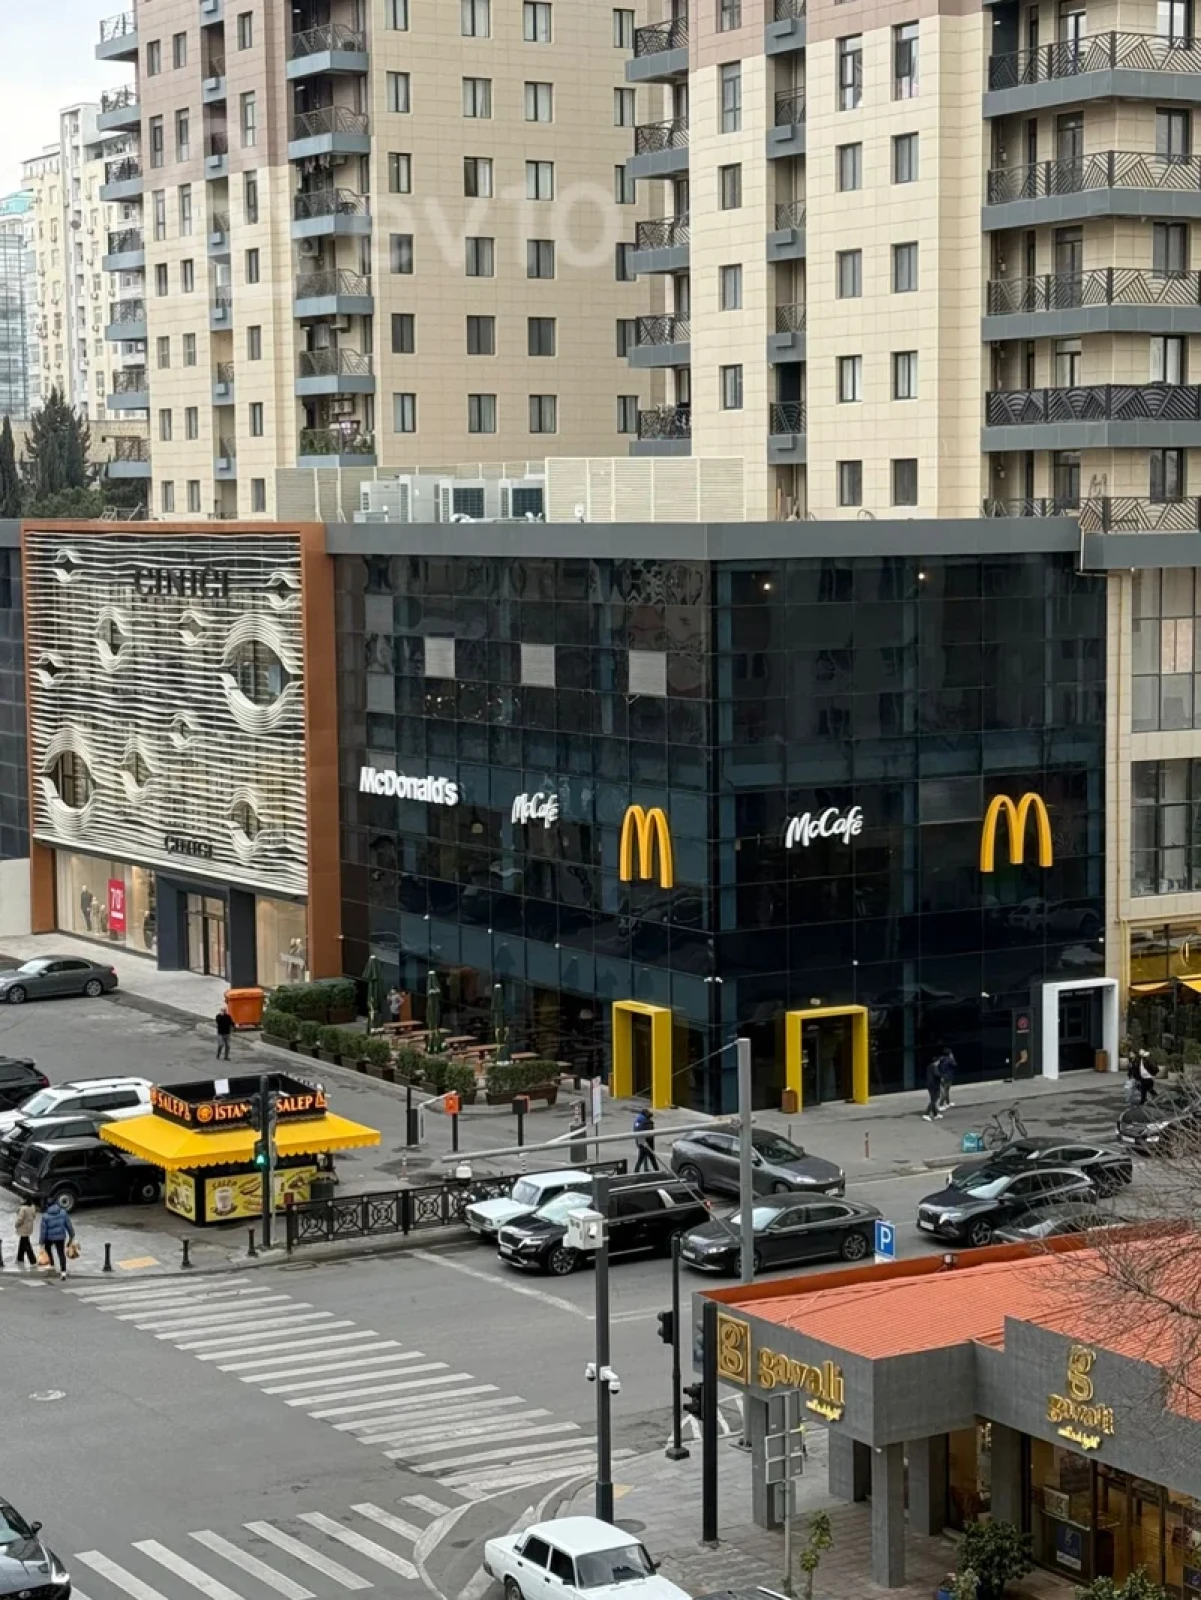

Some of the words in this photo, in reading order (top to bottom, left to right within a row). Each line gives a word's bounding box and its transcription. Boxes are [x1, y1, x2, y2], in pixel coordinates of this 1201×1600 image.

[359, 766, 459, 807] McDonald's
[158, 1092, 185, 1118] SALEP
[276, 1095, 313, 1113] SALEP
[880, 1225, 891, 1250] P
[721, 1322, 744, 1373] g
